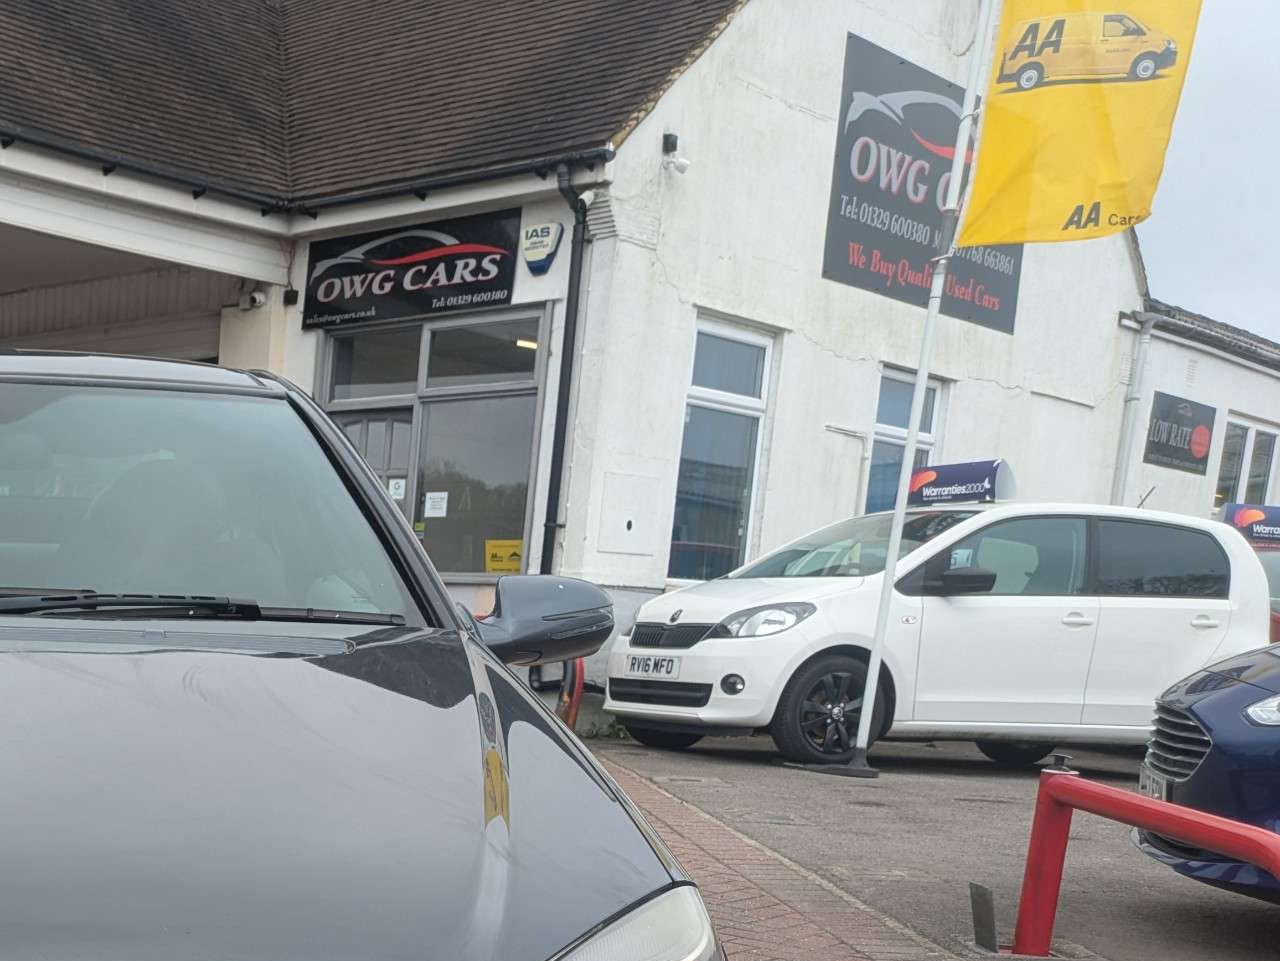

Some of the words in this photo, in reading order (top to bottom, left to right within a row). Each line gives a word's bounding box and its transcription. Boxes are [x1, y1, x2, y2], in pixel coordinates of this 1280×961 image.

[1009, 19, 1066, 60] AA
[850, 136, 930, 204] OWG
[525, 227, 550, 240] IAS
[839, 195, 858, 219] Tel:
[859, 204, 890, 231] 01329
[891, 214, 930, 245] 600380
[984, 248, 1015, 275] 663861
[1061, 201, 1101, 231] AA
[317, 269, 395, 302] OWG
[403, 254, 501, 290] CARS
[848, 241, 865, 269] We
[870, 250, 895, 288] Buy
[897, 259, 933, 289] Quali
[945, 274, 975, 301] Used
[975, 284, 1000, 311] Cars
[629, 656, 652, 673] RV16
